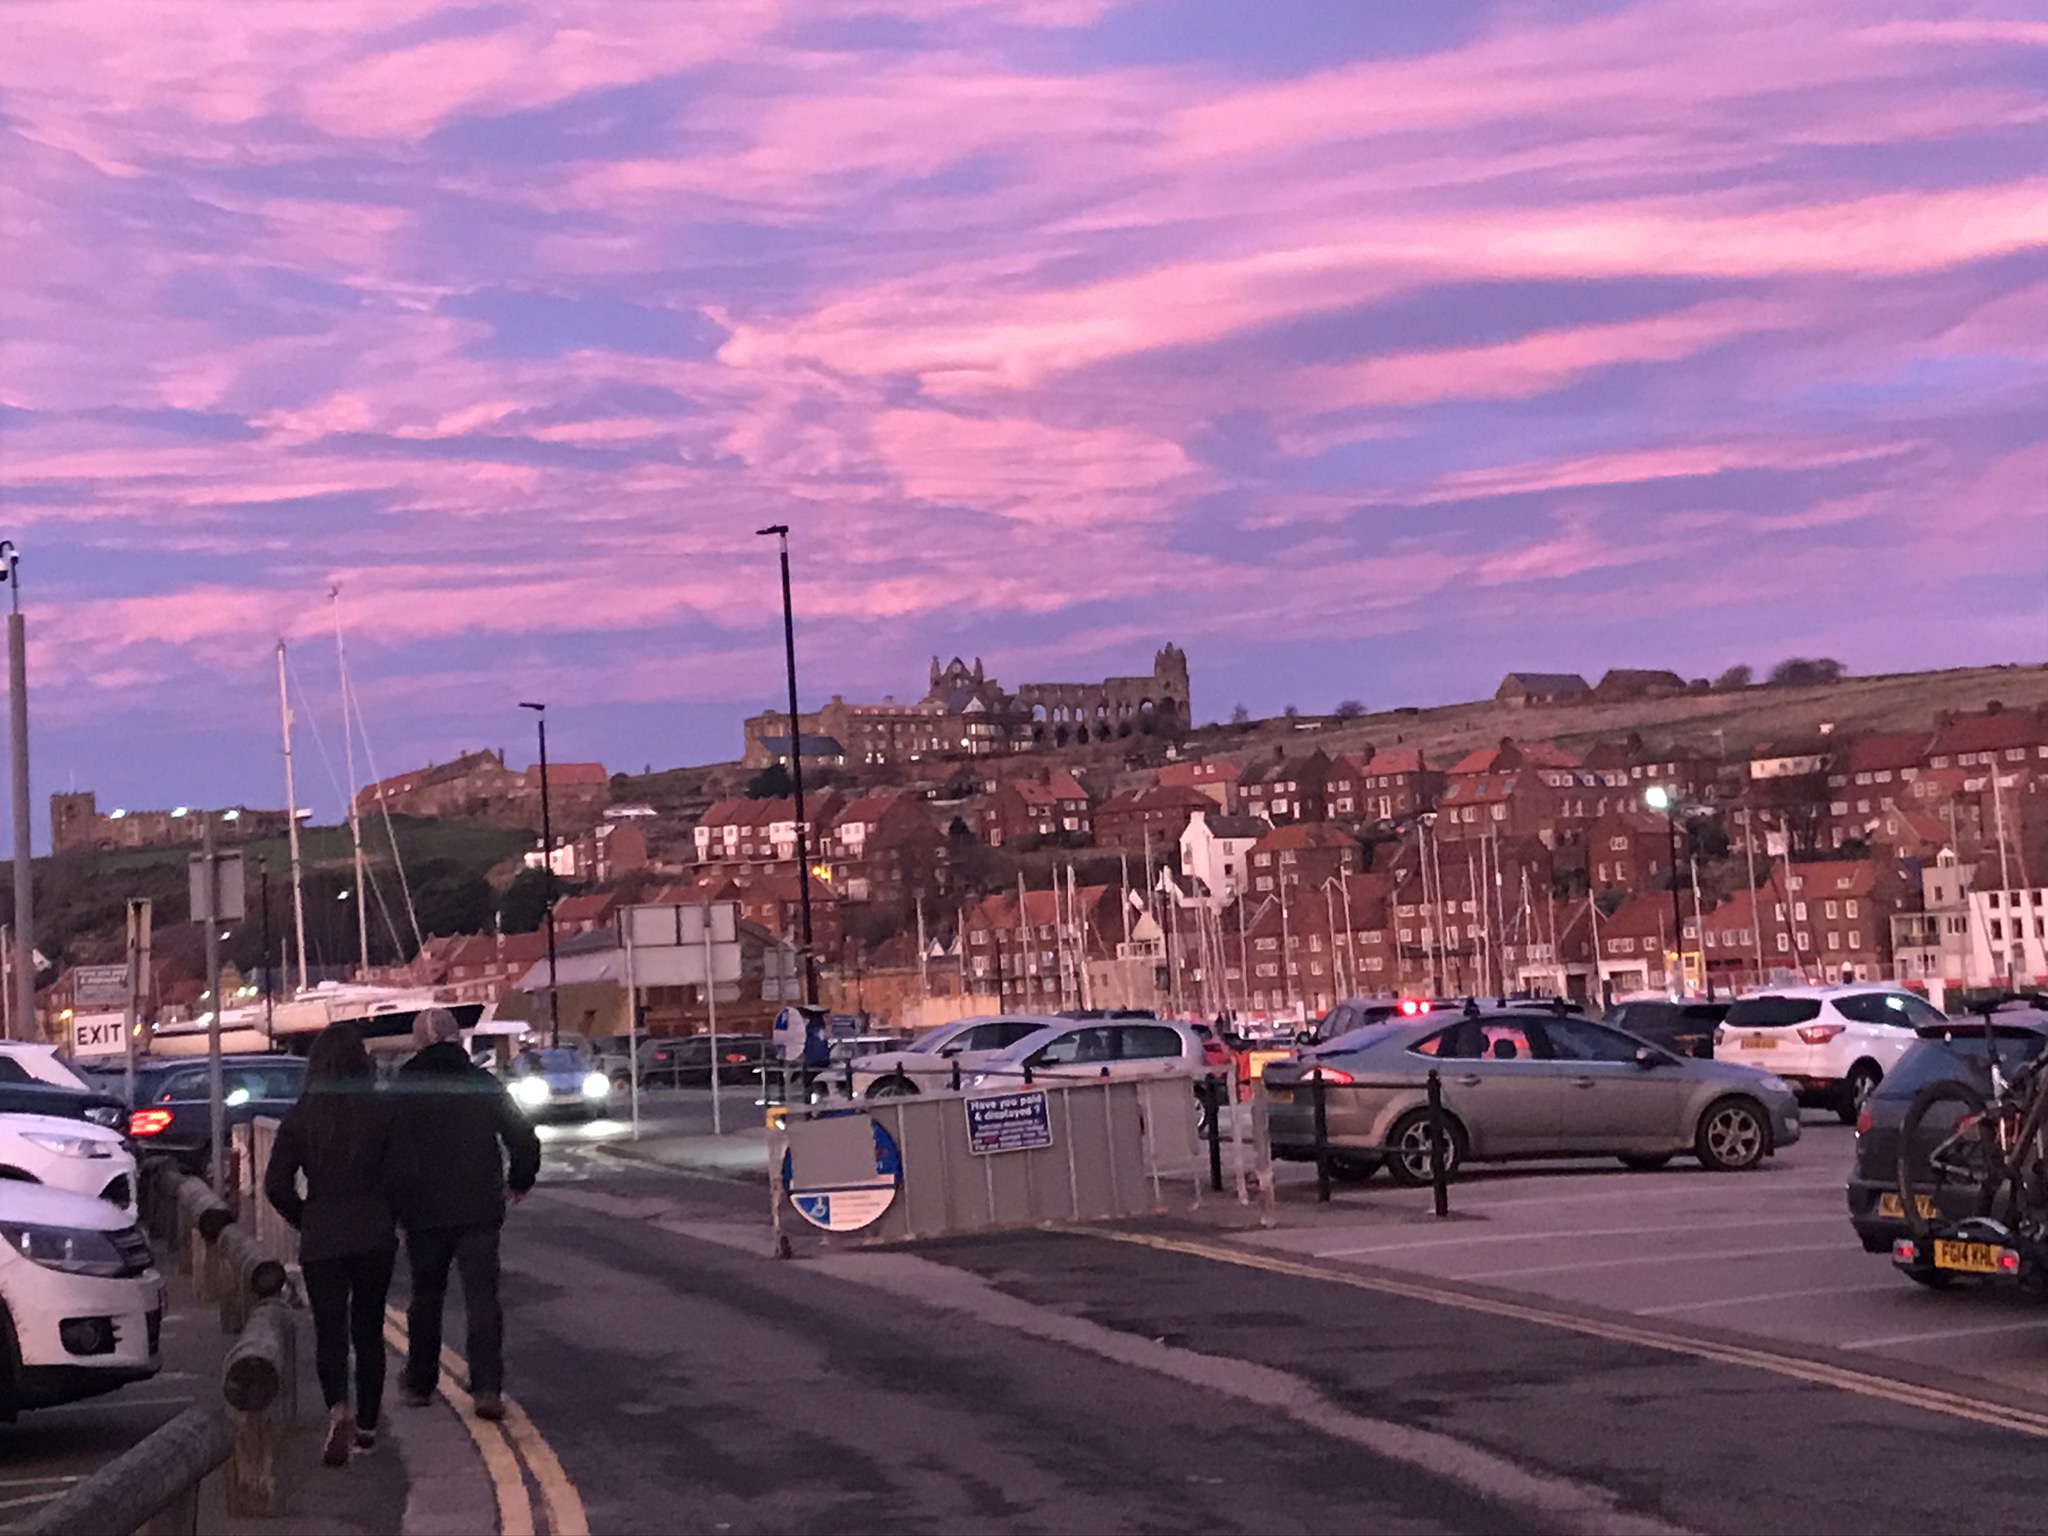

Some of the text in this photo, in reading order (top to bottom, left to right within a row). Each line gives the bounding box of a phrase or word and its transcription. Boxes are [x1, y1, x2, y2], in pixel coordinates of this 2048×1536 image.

[77, 1023, 122, 1046] EXIT
[970, 1094, 1042, 1111] Have you paid
